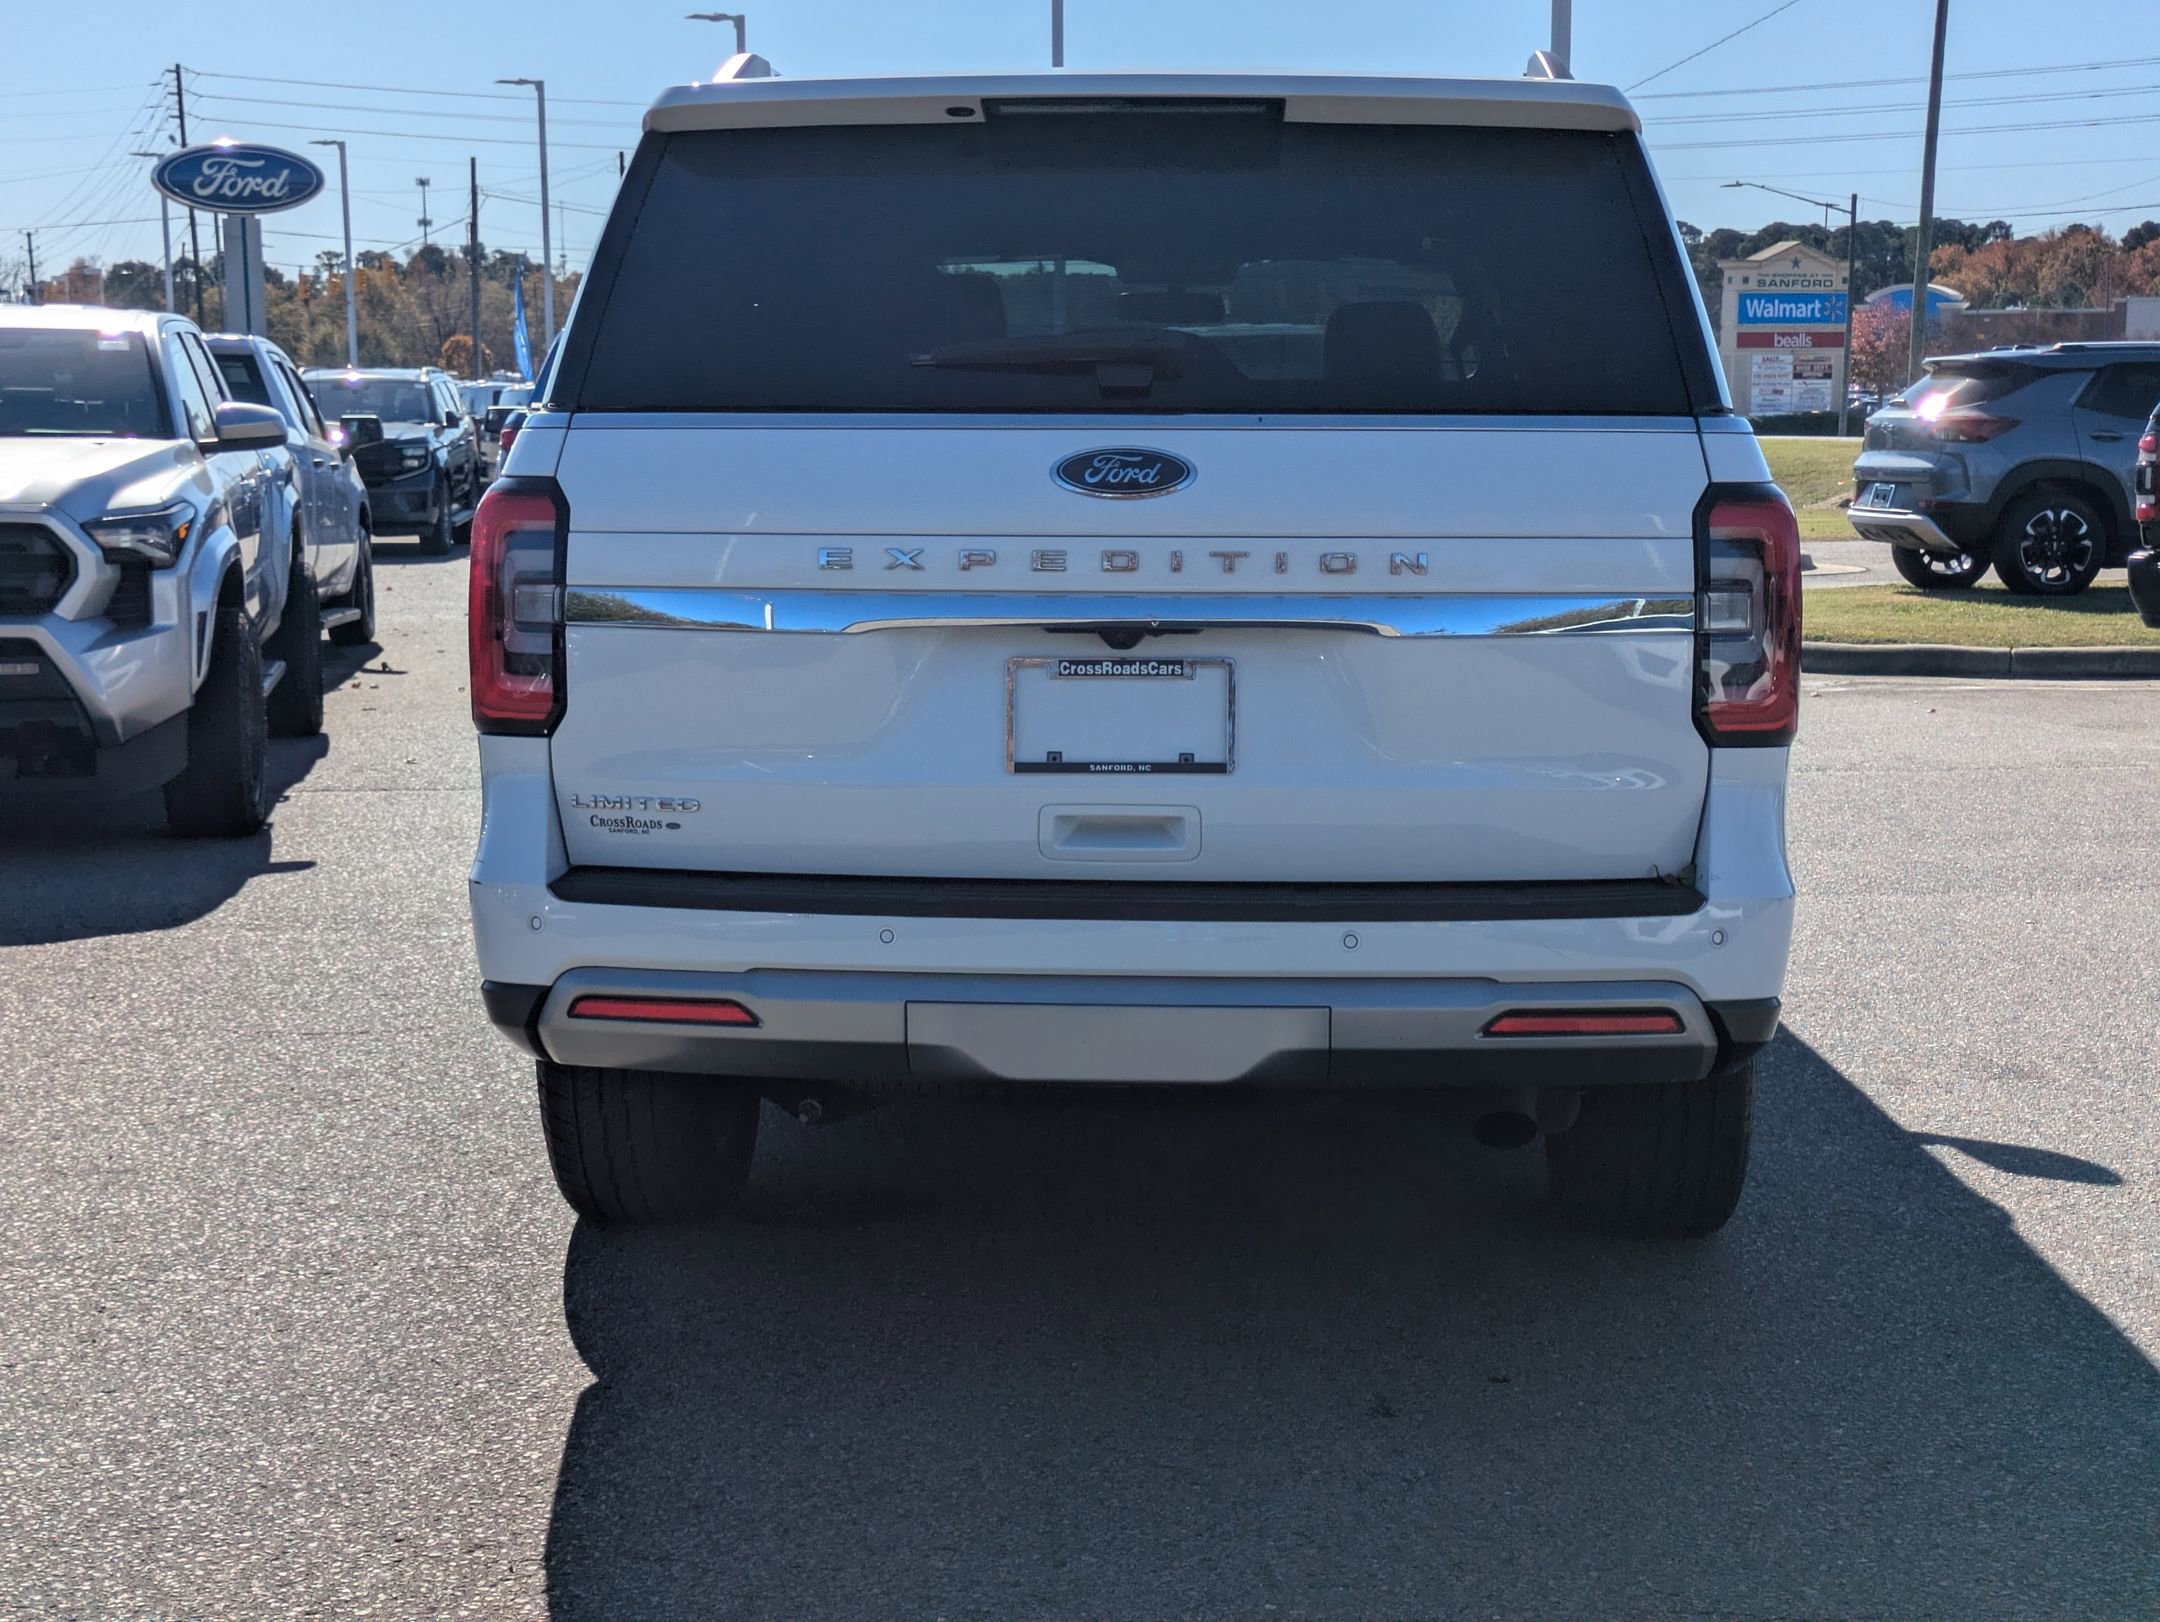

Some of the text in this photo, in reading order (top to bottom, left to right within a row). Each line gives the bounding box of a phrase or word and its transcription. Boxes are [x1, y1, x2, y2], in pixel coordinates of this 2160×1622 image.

[193, 157, 290, 197] Ford
[1757, 279, 1834, 288] SANFORD
[1745, 298, 1822, 318] Walmart
[1774, 333, 1812, 348] bealls
[1084, 454, 1162, 484] Ford
[817, 547, 1429, 575] EXPEDITION
[1059, 661, 1182, 675] CrossRoadsCars
[1138, 764, 1152, 772] NC
[571, 793, 701, 813] LIMITED
